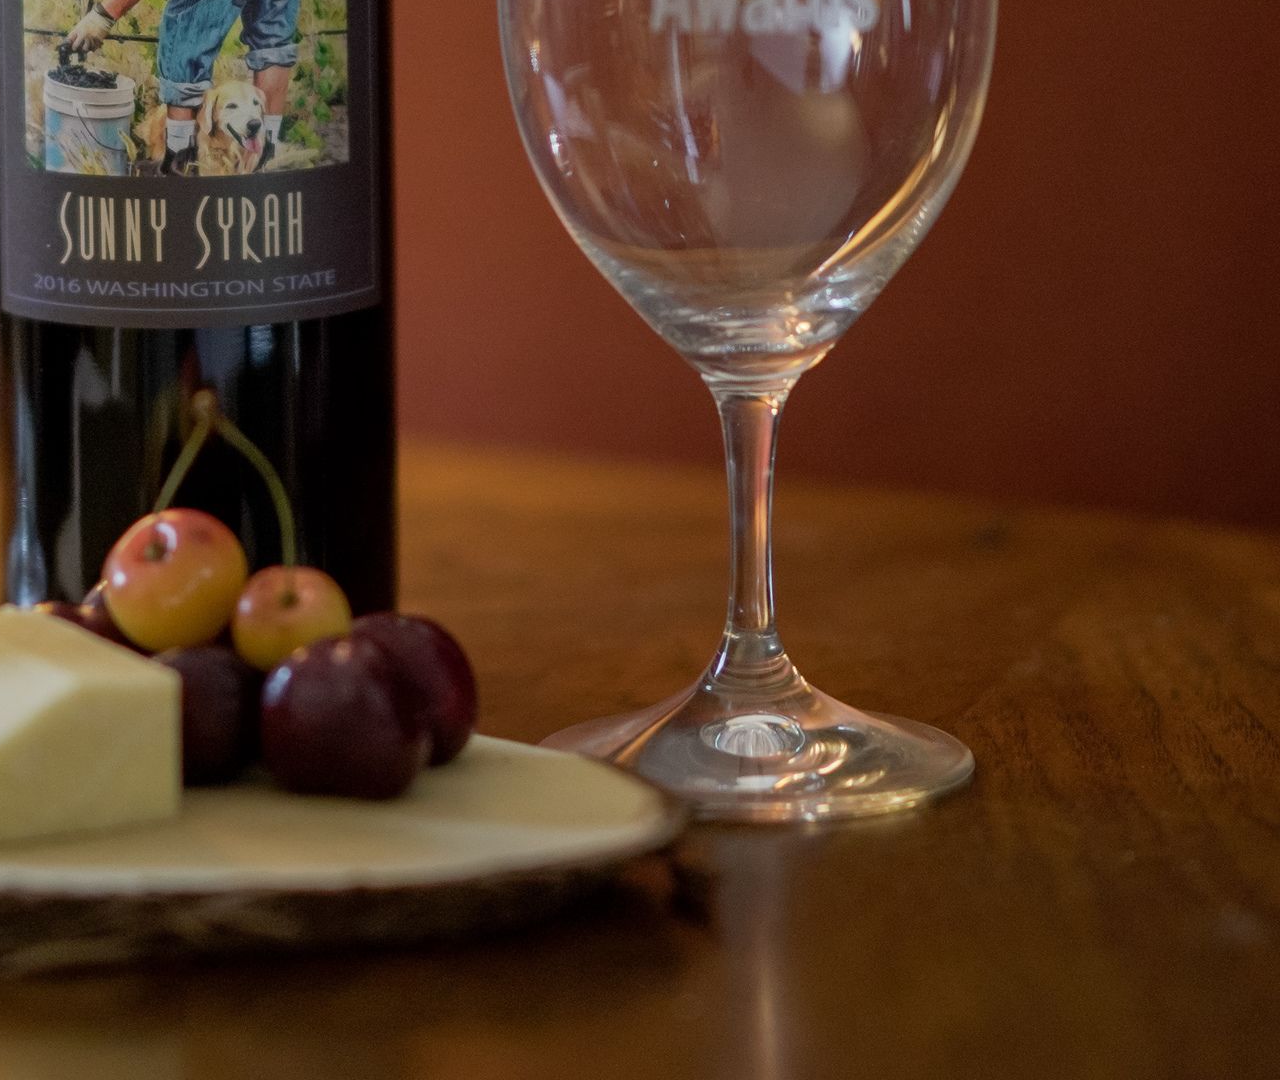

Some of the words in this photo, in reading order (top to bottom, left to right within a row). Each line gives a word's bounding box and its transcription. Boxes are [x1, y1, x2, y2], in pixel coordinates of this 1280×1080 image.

[58, 190, 167, 265] SUNNY
[194, 190, 304, 270] SYRAH
[33, 272, 82, 295] 2016
[86, 278, 266, 298] WASHINGTON
[272, 267, 337, 291] STATE
